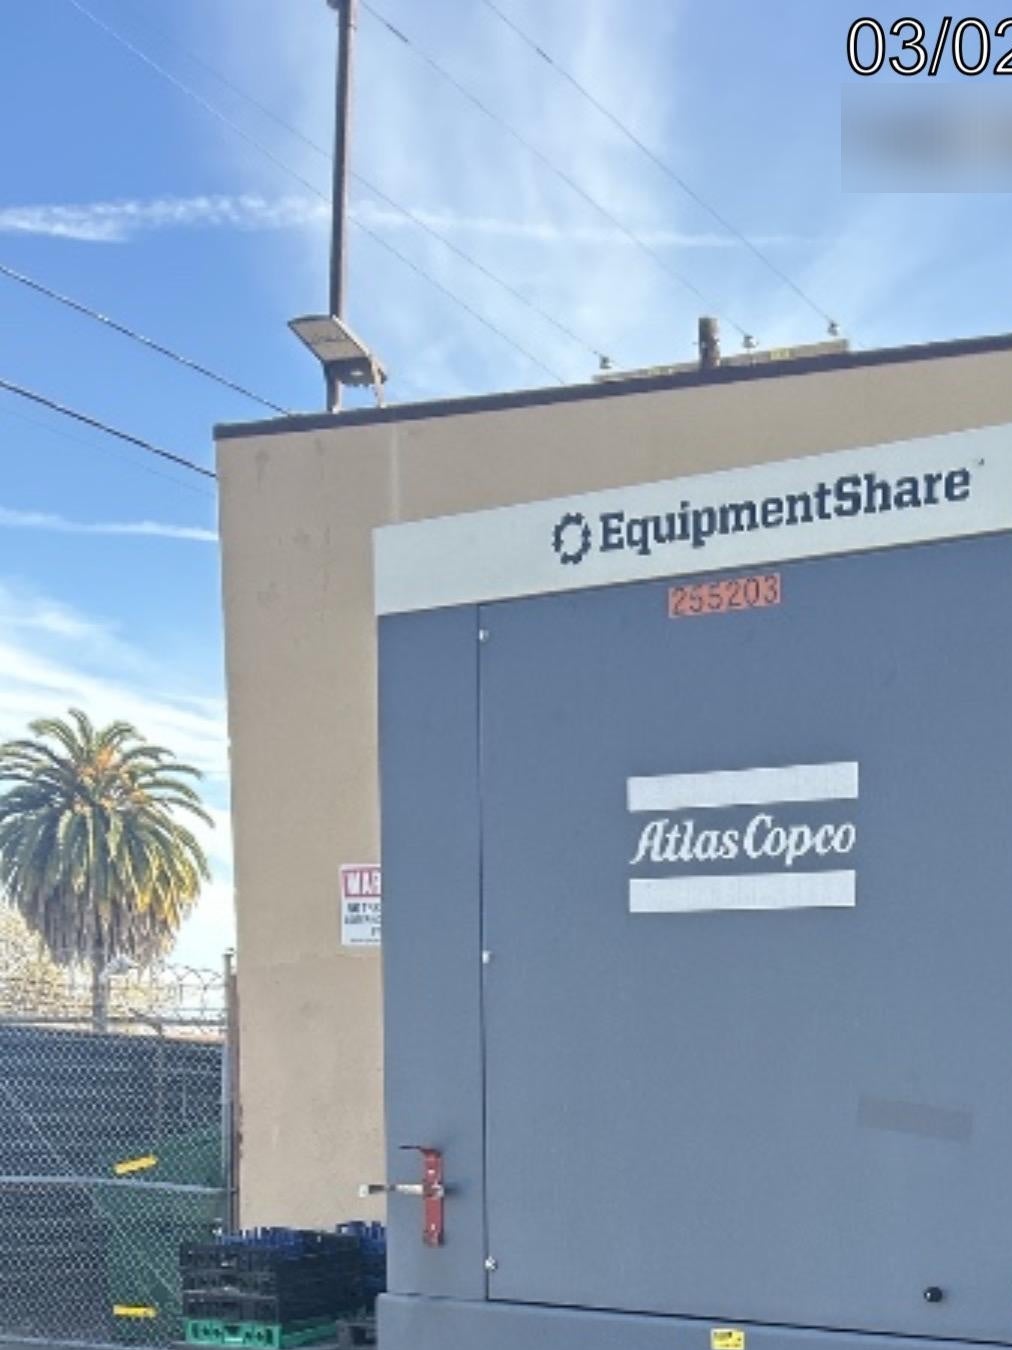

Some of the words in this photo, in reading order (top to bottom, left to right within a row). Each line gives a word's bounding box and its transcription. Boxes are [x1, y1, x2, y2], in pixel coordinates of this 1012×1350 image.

[599, 467, 971, 556] EquipmentShare
[671, 575, 778, 615] 255203
[629, 818, 740, 865] Atlas
[742, 812, 857, 867] Copco
